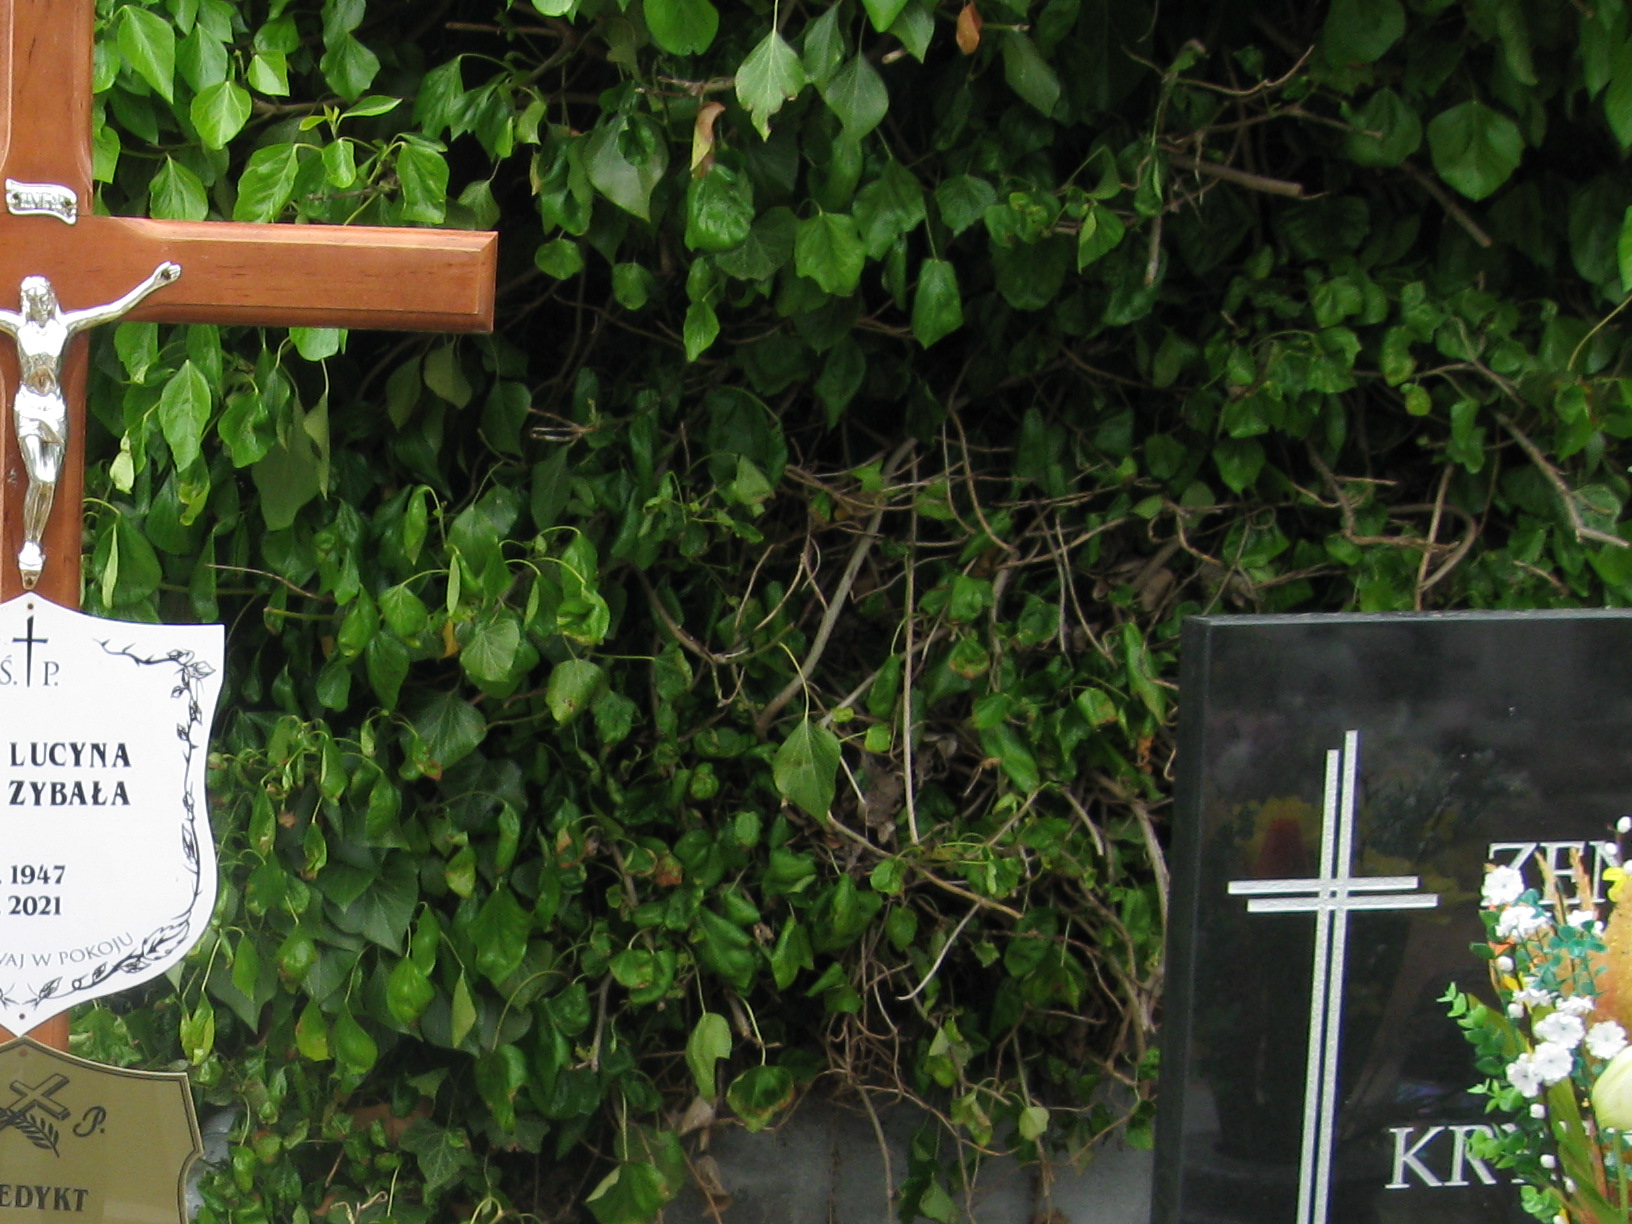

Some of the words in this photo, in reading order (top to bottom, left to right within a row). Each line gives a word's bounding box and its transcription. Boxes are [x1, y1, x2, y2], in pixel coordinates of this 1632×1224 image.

[9, 741, 132, 768] LUCYNA
[9, 780, 131, 807] ZYBAŁA
[31, 952, 52, 968] W
[59, 931, 134, 965] POKOJU
